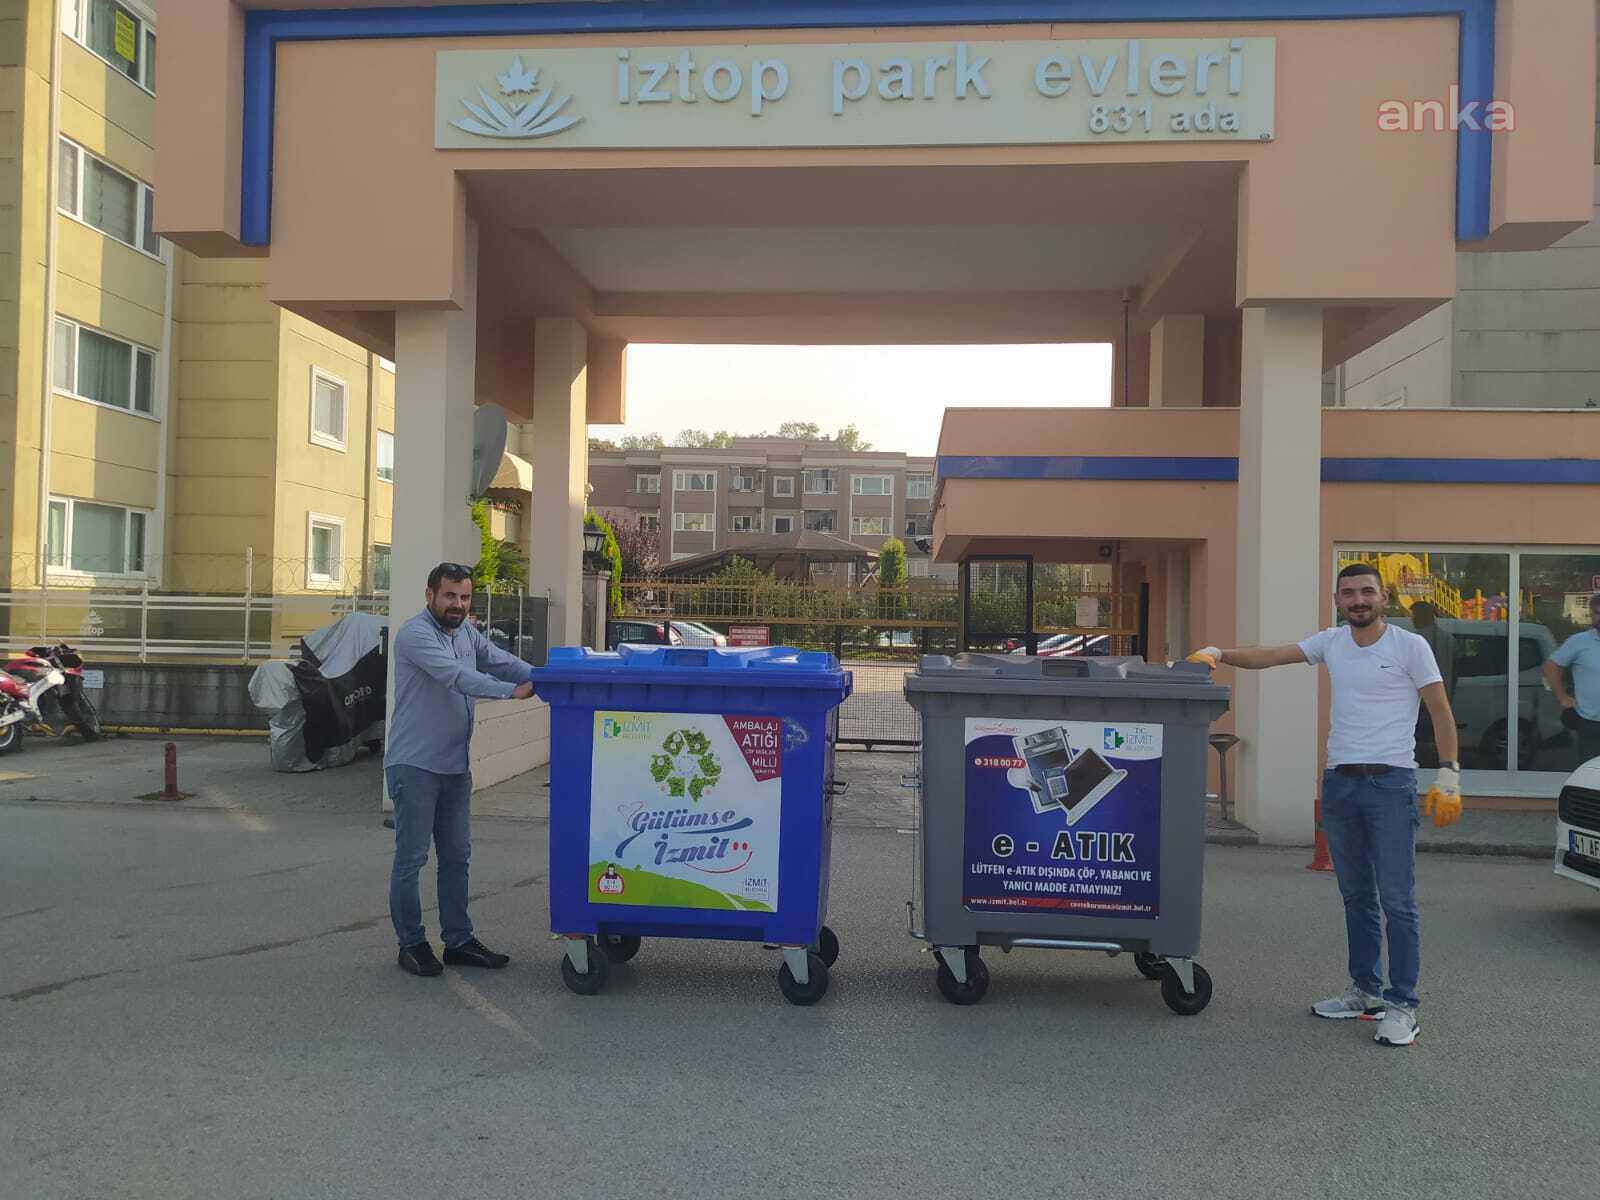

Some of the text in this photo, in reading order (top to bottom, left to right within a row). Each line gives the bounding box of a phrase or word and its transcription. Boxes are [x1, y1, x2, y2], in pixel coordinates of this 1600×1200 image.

[617, 39, 1244, 117] iztop park evleri
[1089, 102, 1241, 134] 831 ada
[733, 720, 778, 731] AMBALAJ
[741, 731, 778, 748] ATIĞI
[1000, 759, 1011, 768] 00
[1012, 759, 1023, 768] 77
[631, 808, 736, 834] Gülümse
[992, 834, 1015, 858] e
[1051, 830, 1136, 863] ATIK
[971, 862, 1152, 881] LÜTFEN e-ATIK DIŞINDA ÇÖP, YABANCI VE
[1003, 880, 1122, 896] YANICI MADDE ATMAYINIZ!
